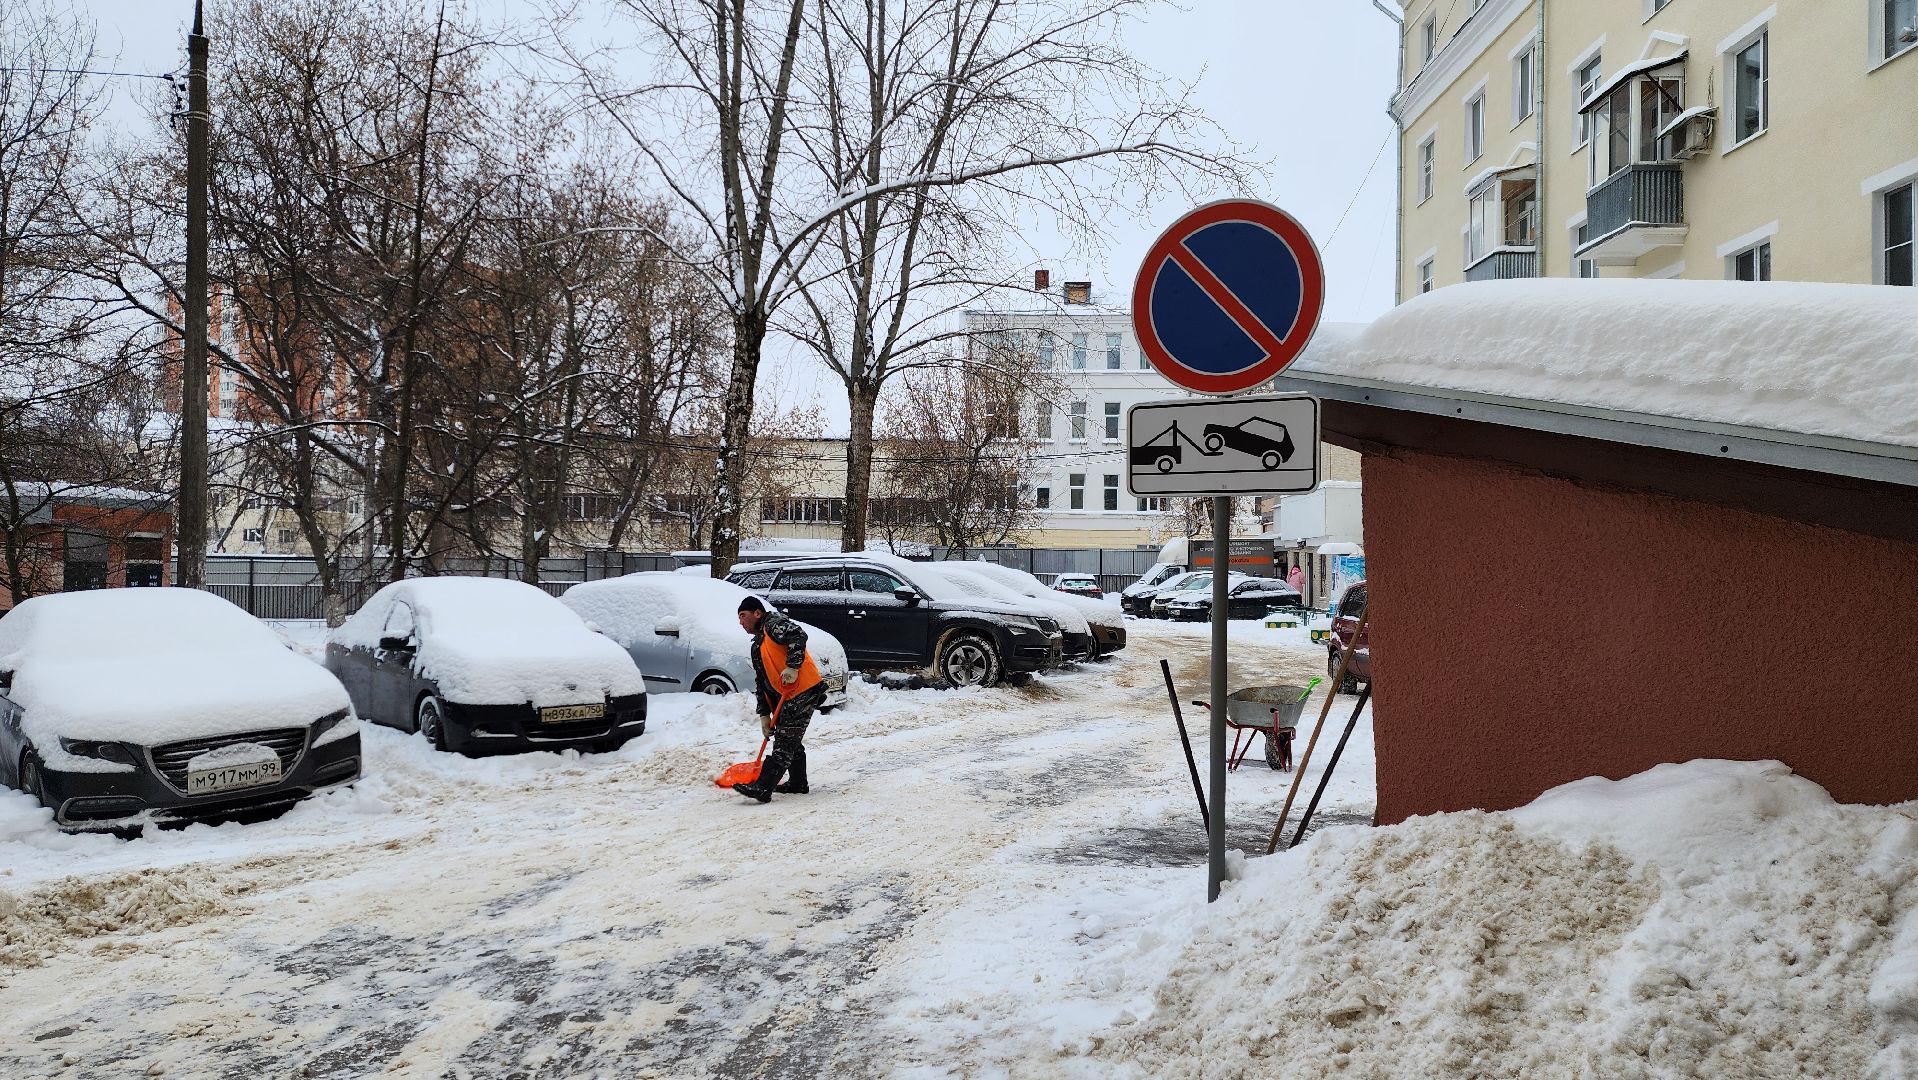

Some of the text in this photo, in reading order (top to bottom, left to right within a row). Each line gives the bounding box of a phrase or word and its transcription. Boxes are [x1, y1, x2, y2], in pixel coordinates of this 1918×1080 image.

[544, 705, 601, 720] М893КА 750
[196, 769, 258, 787] М917ММ
[261, 762, 276, 775] 99
